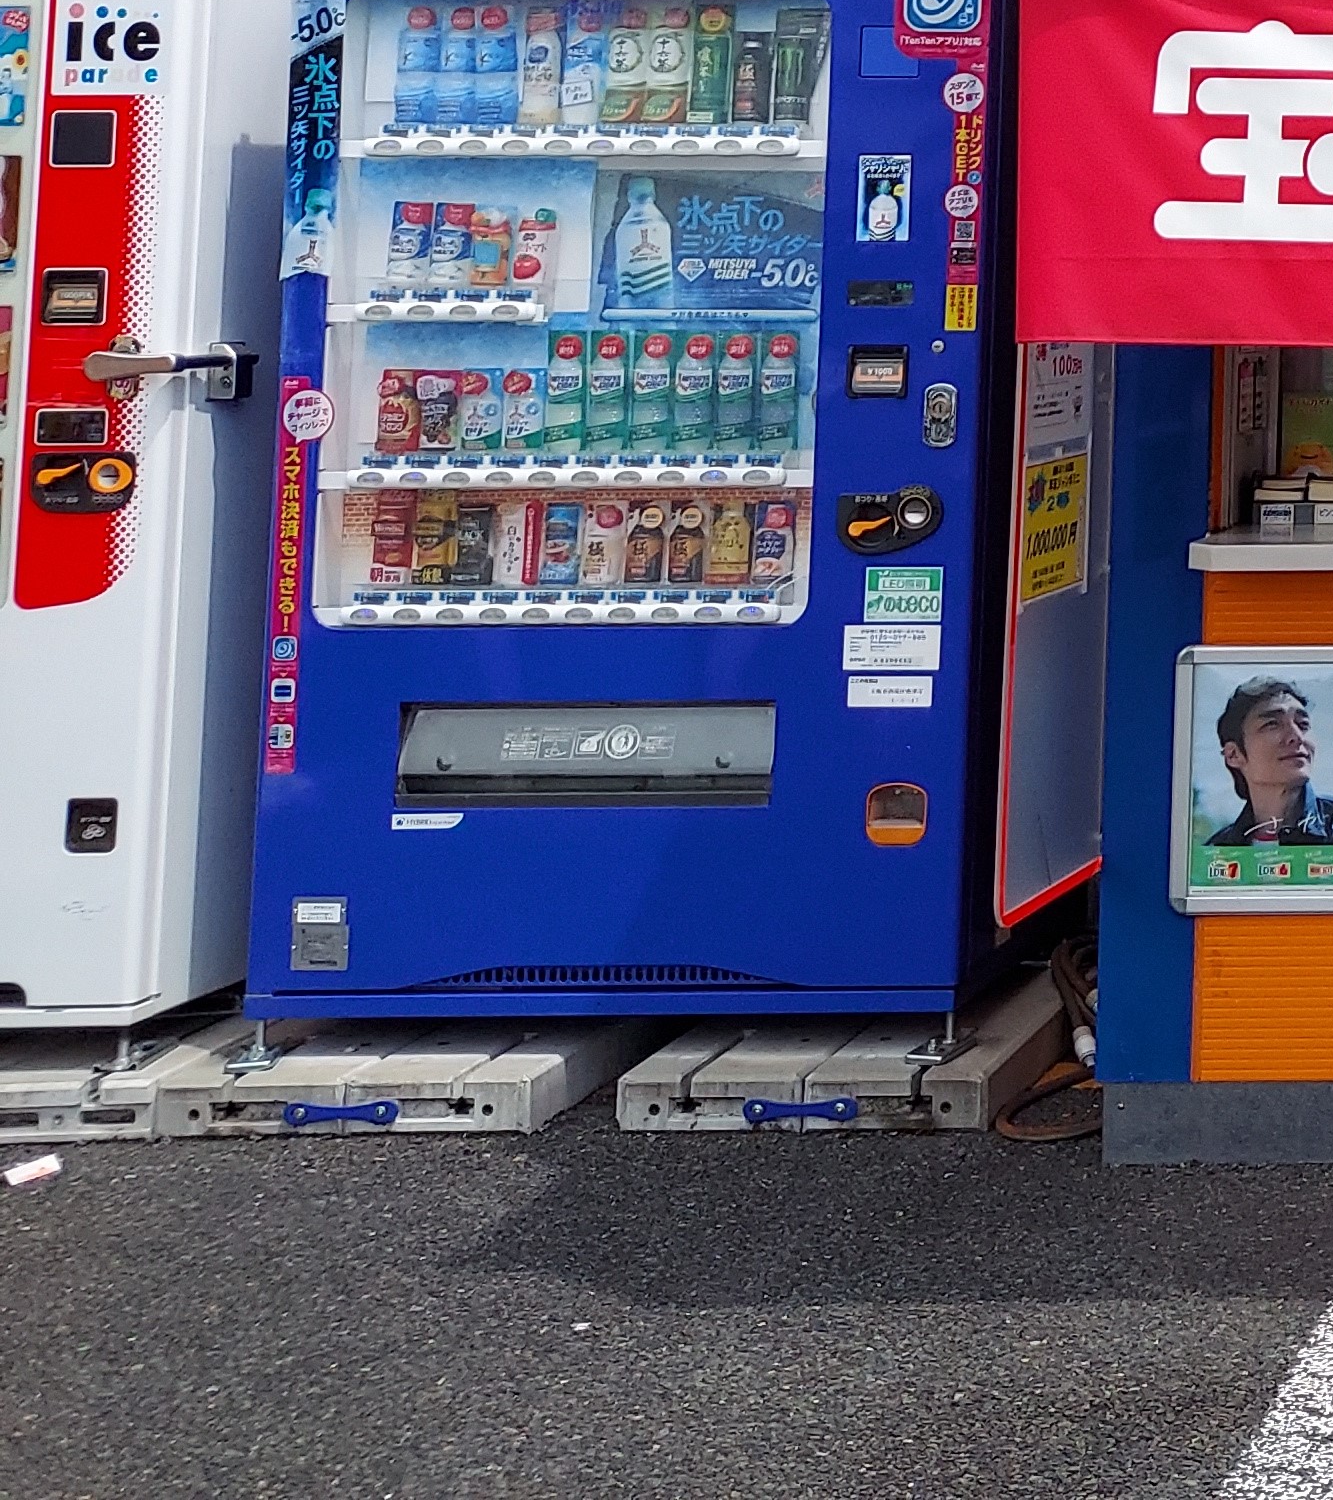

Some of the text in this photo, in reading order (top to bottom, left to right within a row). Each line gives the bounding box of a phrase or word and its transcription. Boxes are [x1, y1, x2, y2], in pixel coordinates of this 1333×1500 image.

[304, 52, 340, 162] 氷点下の
[289, 84, 311, 205] 三ツ矢サイダー
[968, 114, 984, 170] ドリンク
[677, 195, 785, 234] 氷点下の
[677, 234, 823, 256] 三ツ矢サイダー
[708, 258, 756, 270] MITSUYA
[714, 269, 750, 280] CIDER
